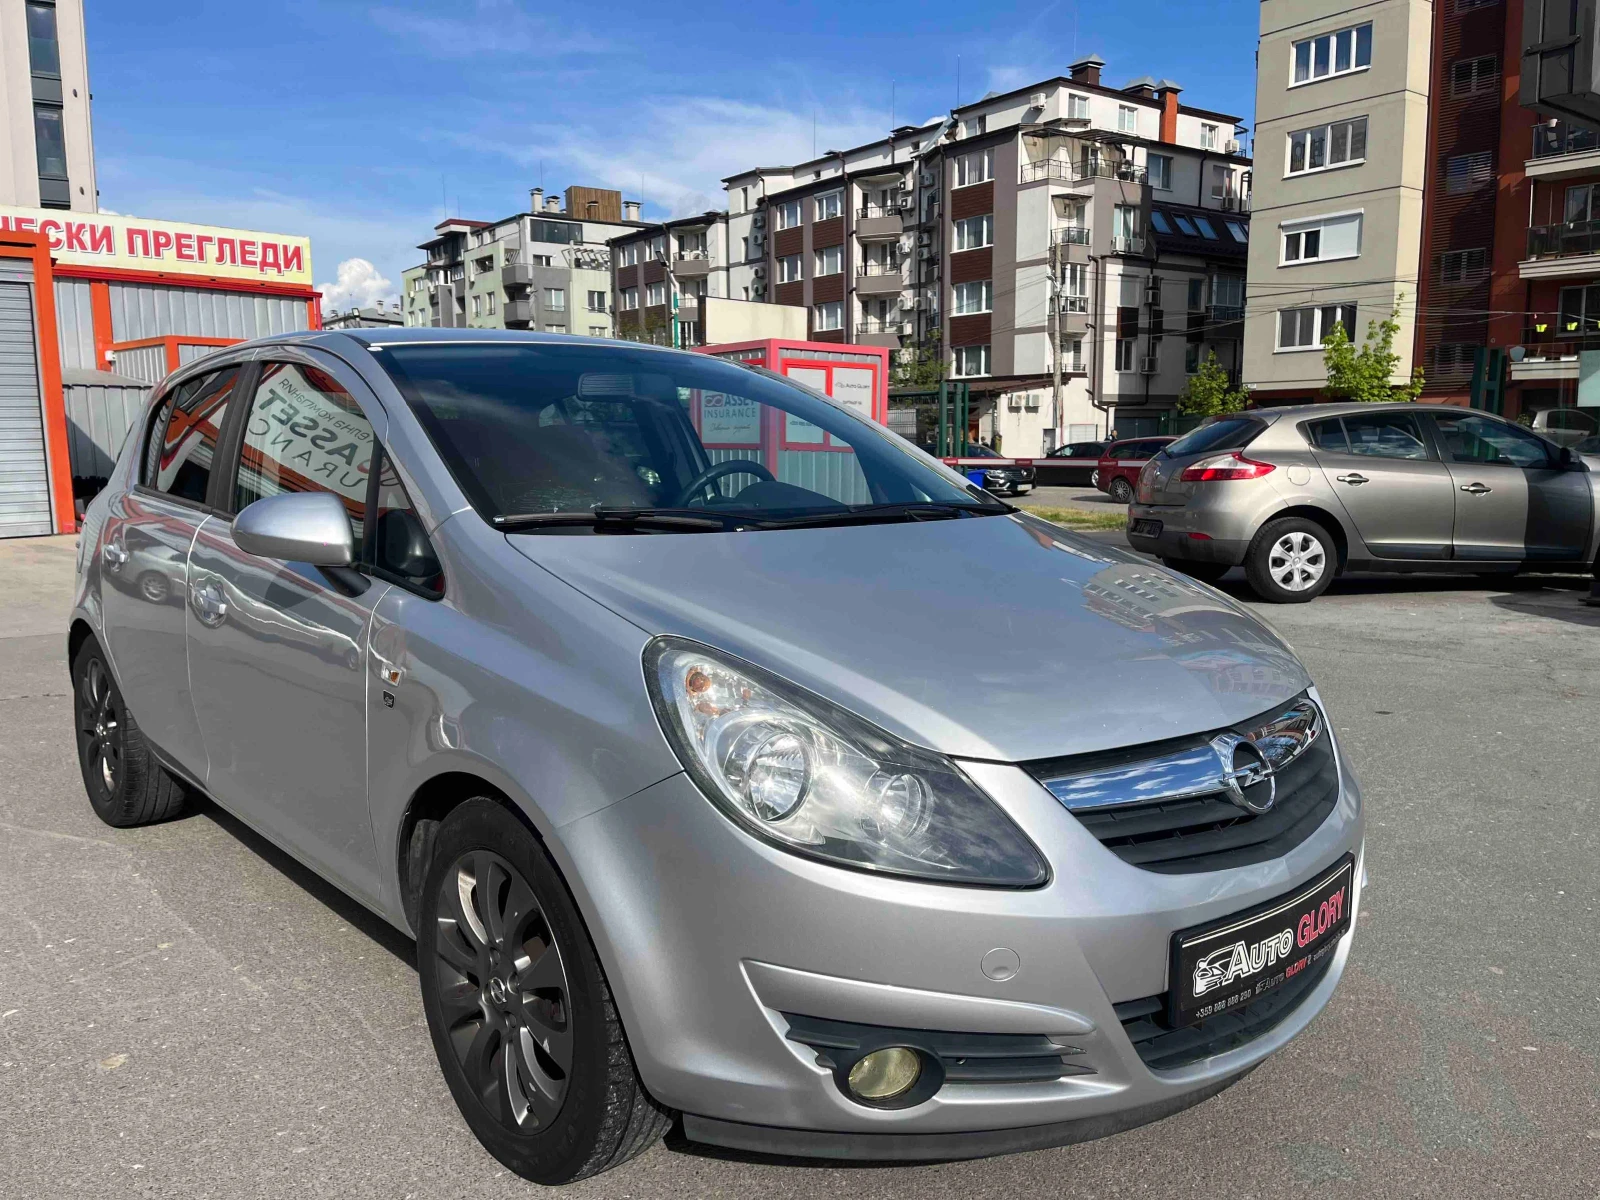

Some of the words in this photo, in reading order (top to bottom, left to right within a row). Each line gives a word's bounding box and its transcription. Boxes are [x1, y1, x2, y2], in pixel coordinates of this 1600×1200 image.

[126, 227, 303, 274] ПРЕГЛЕДИ
[704, 407, 757, 418] INSURANCE
[1222, 928, 1293, 985] AUTO
[1297, 886, 1345, 948] GLORY
[1195, 1005, 1213, 1018] +359
[1285, 957, 1307, 978] GLORY
